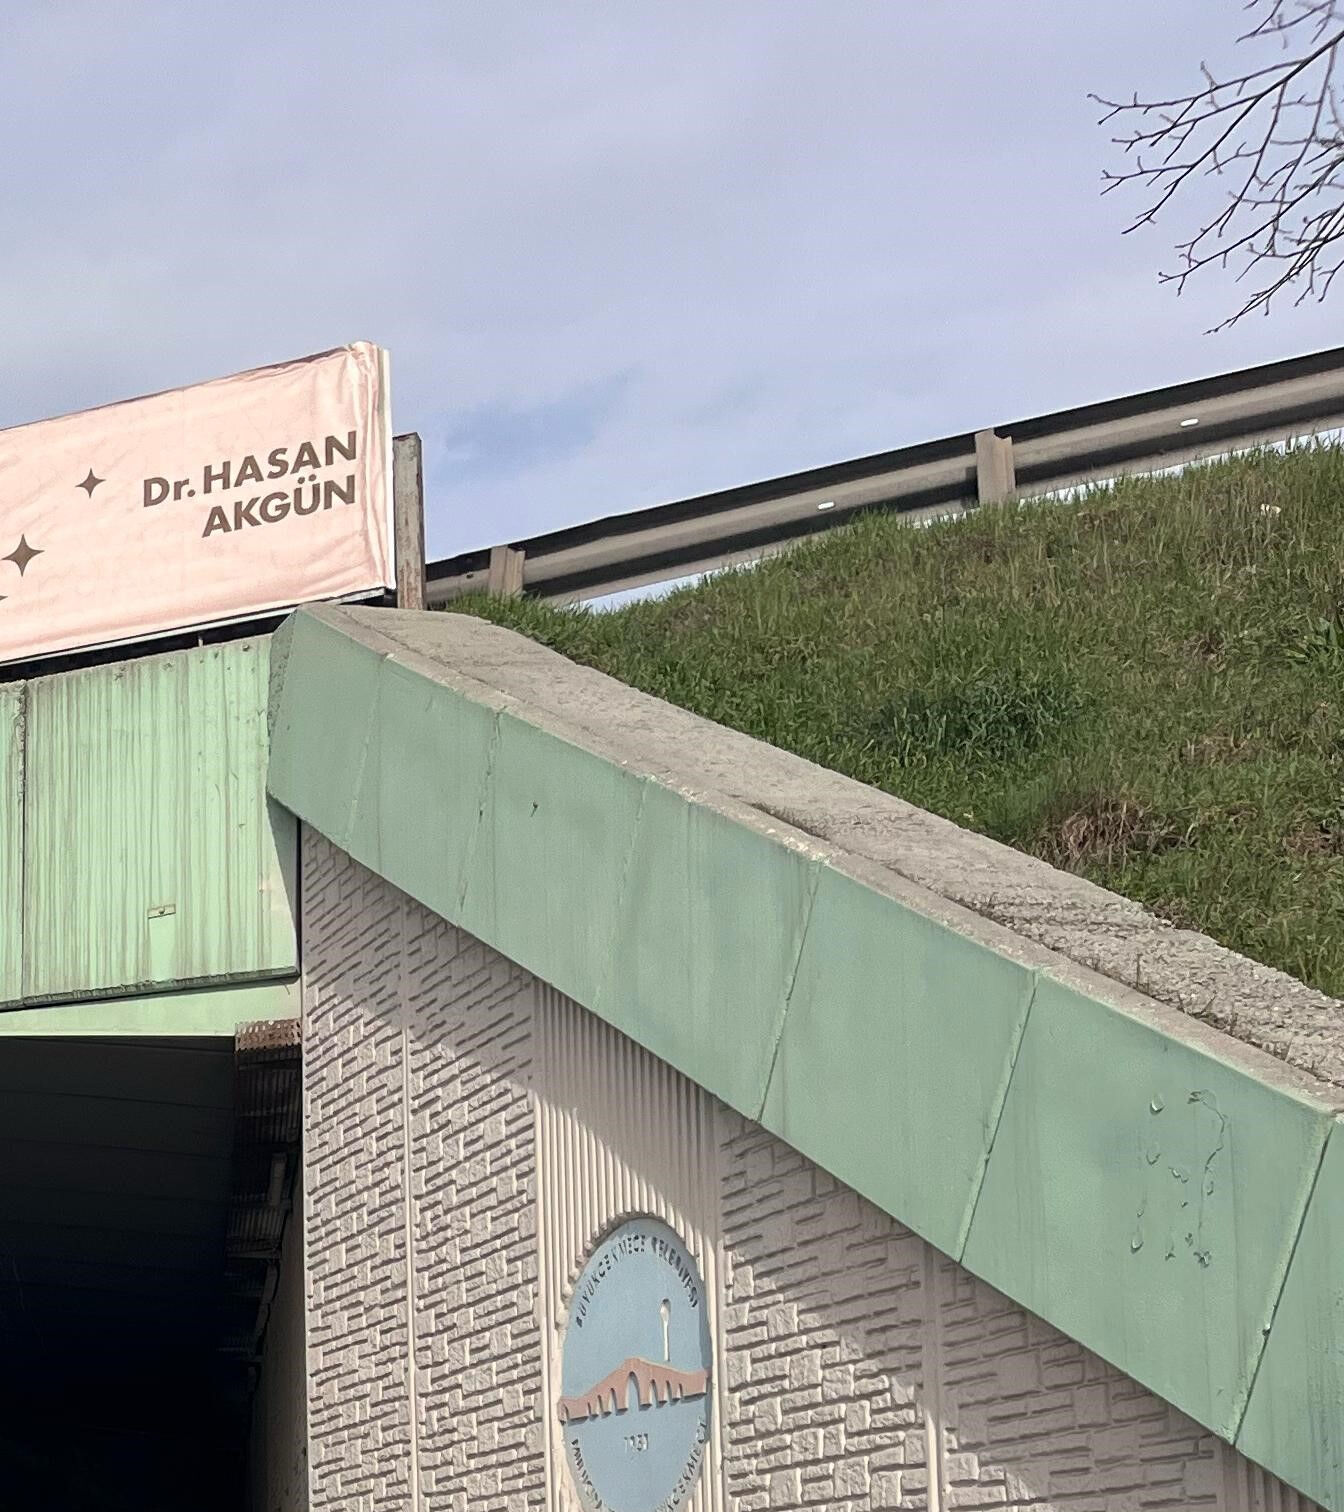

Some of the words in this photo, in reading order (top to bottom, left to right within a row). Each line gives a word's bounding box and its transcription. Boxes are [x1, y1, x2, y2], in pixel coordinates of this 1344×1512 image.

[143, 476, 196, 507] Dr.
[203, 430, 357, 494] HASAN
[202, 473, 355, 538] AKGÜN
